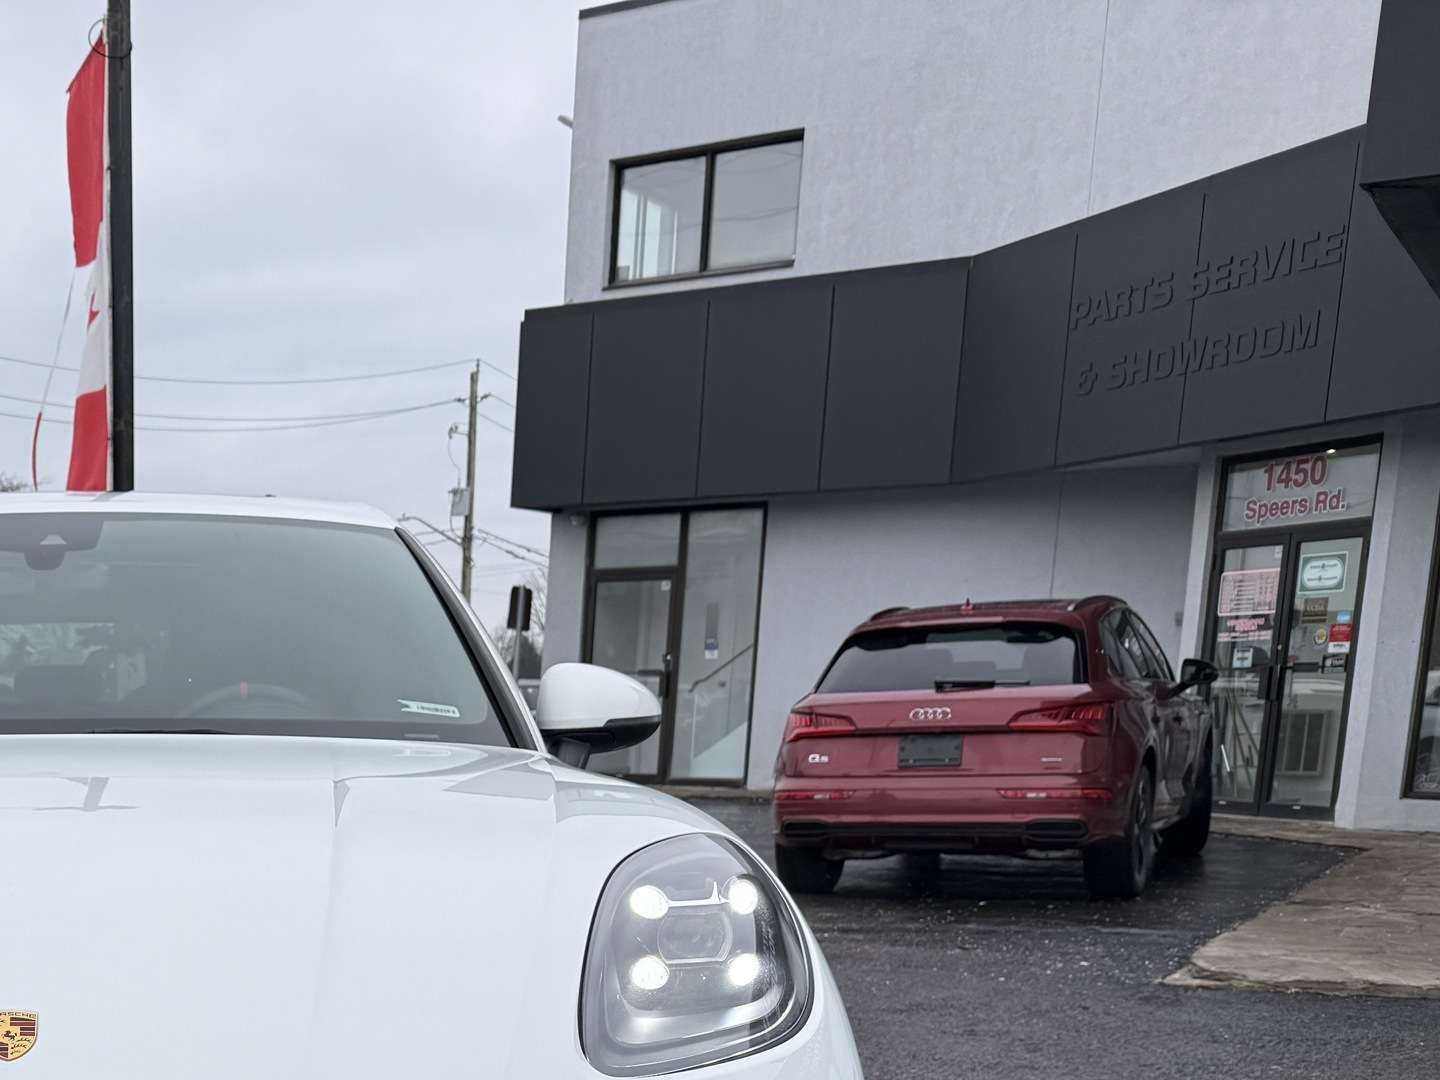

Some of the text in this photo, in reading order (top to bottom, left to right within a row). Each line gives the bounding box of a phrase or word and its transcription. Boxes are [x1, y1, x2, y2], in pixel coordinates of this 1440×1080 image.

[1069, 224, 1346, 330] PARTS SERVICE
[1075, 308, 1321, 396] & SHOWROOM
[1264, 456, 1329, 491] 1450
[1245, 488, 1346, 524] Speers Rd.
